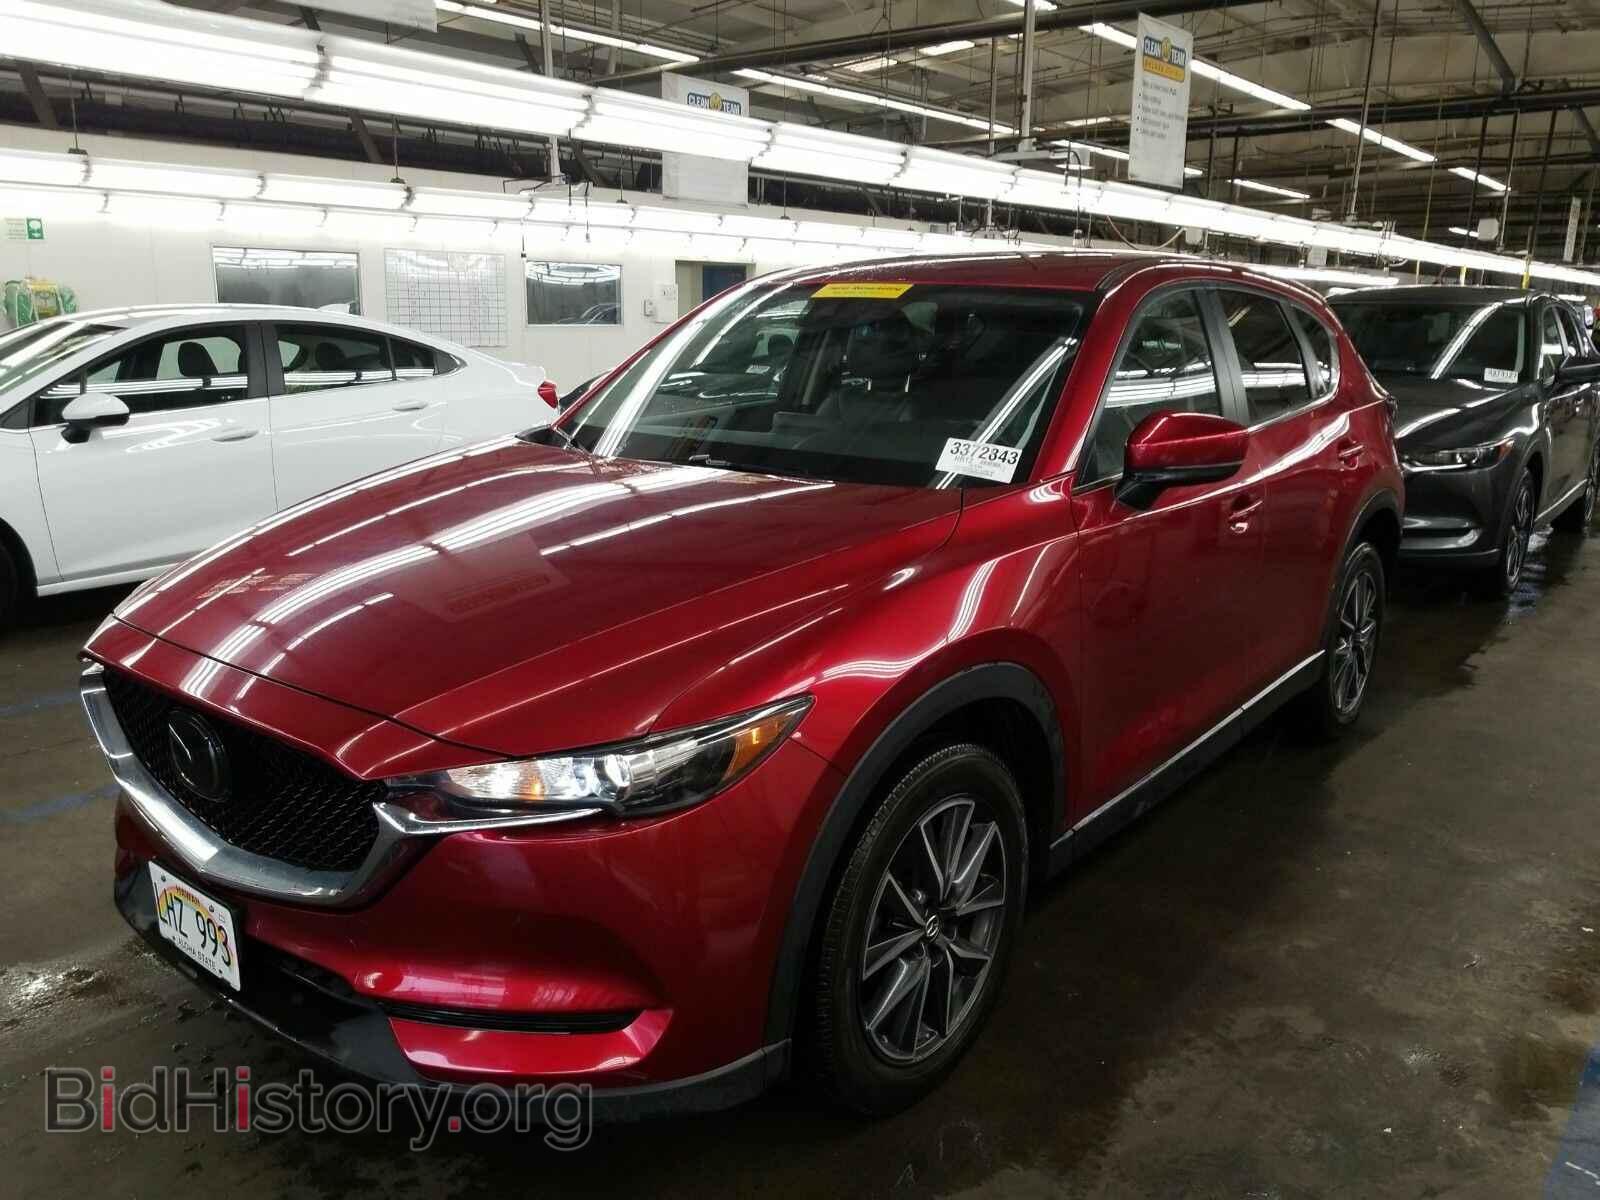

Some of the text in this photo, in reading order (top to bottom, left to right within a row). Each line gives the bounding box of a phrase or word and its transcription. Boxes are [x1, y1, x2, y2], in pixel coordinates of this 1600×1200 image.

[1144, 39, 1185, 65] CLEAN TEAM
[688, 95, 740, 114] CLEAN TEAM
[950, 441, 1019, 465] 3372343
[154, 881, 232, 967] LHZ 993
